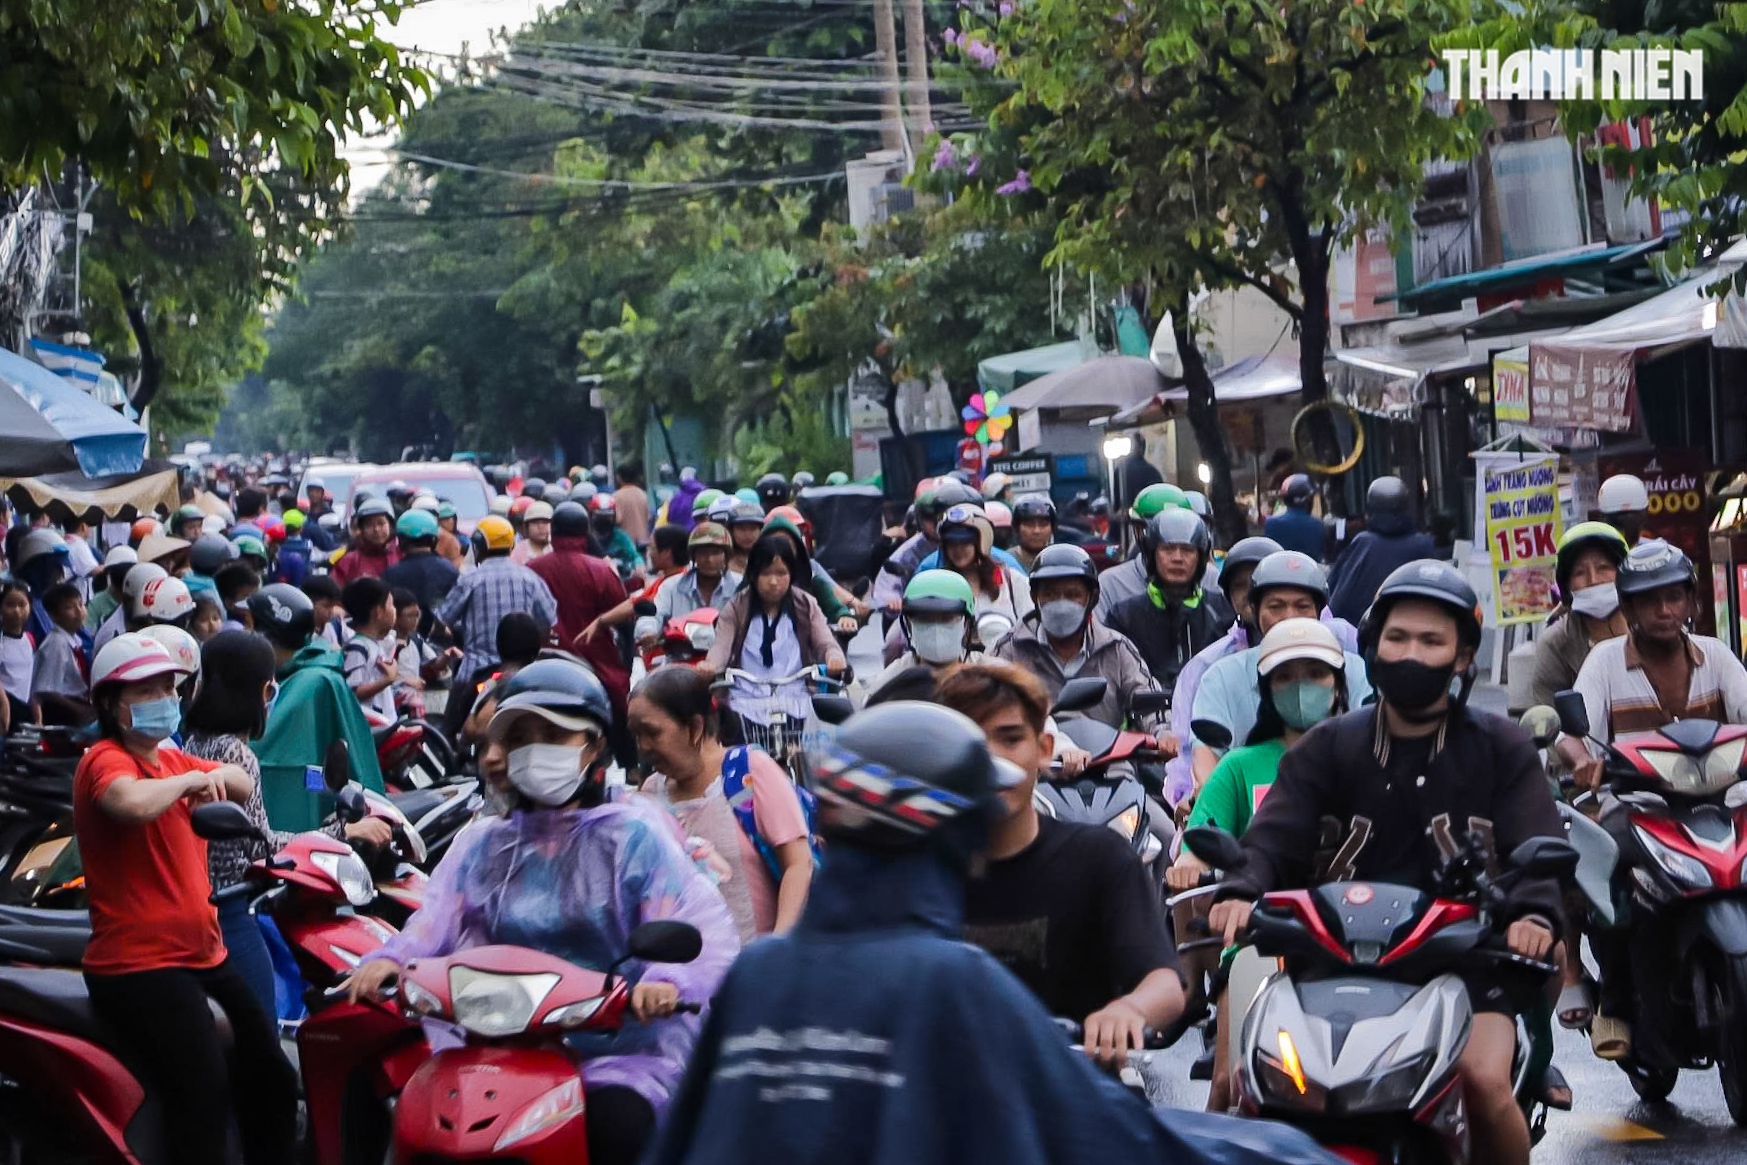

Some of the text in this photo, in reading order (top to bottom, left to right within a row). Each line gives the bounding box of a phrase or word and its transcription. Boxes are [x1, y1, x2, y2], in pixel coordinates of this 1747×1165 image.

[1645, 473, 1697, 491] RÁI CÂY
[1648, 491, 1700, 514] 000
[1496, 522, 1557, 563] 15K
